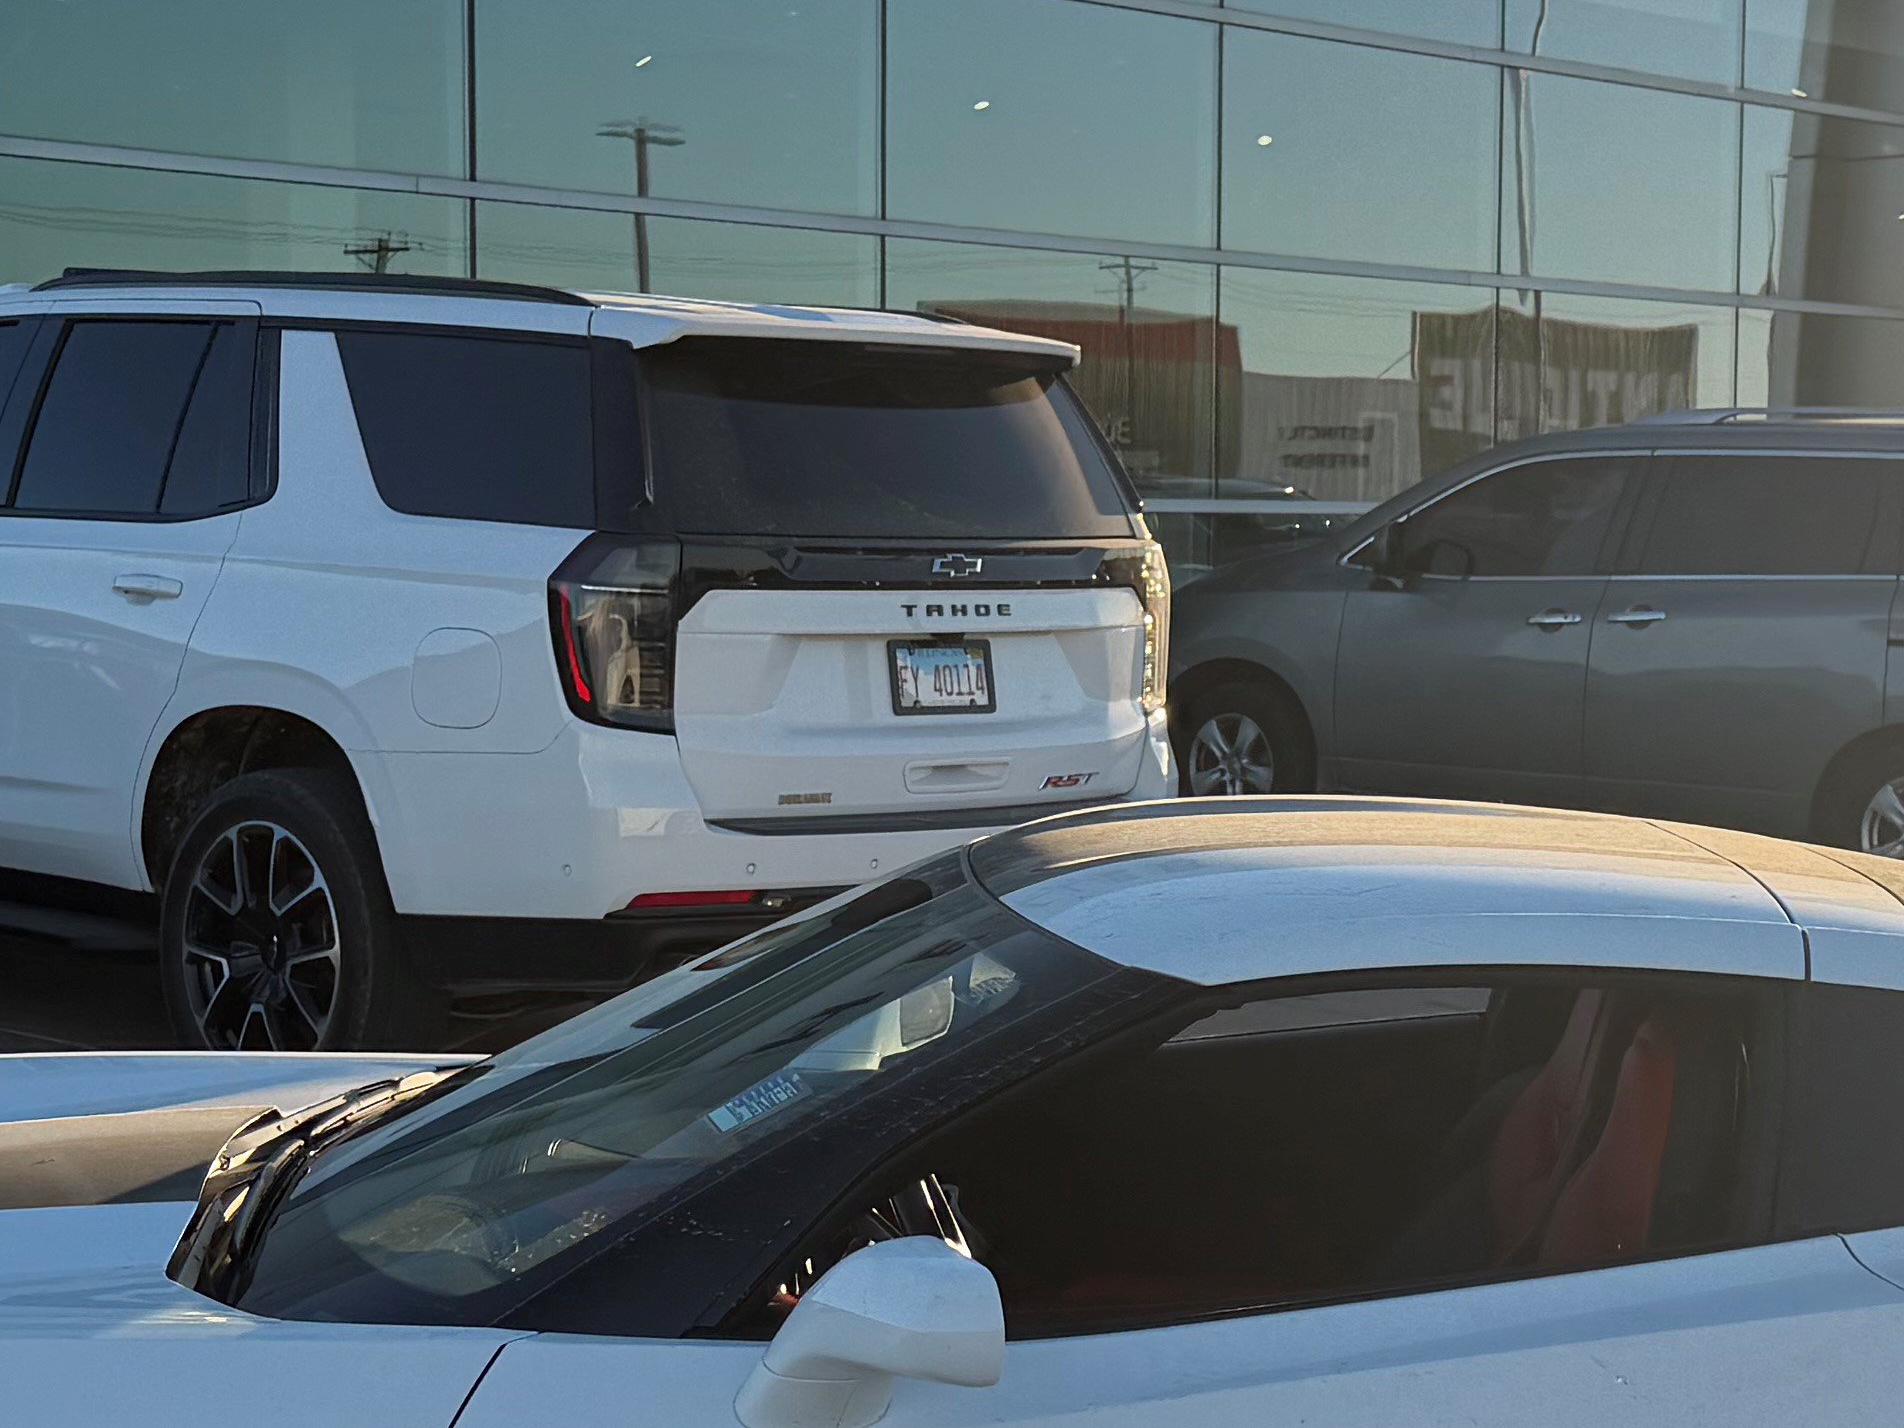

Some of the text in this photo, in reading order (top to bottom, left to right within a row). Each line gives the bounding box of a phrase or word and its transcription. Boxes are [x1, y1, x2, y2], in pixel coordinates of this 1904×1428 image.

[900, 603, 1012, 618] TAHOE
[934, 663, 986, 698] 40114
[1037, 771, 1100, 791] RST
